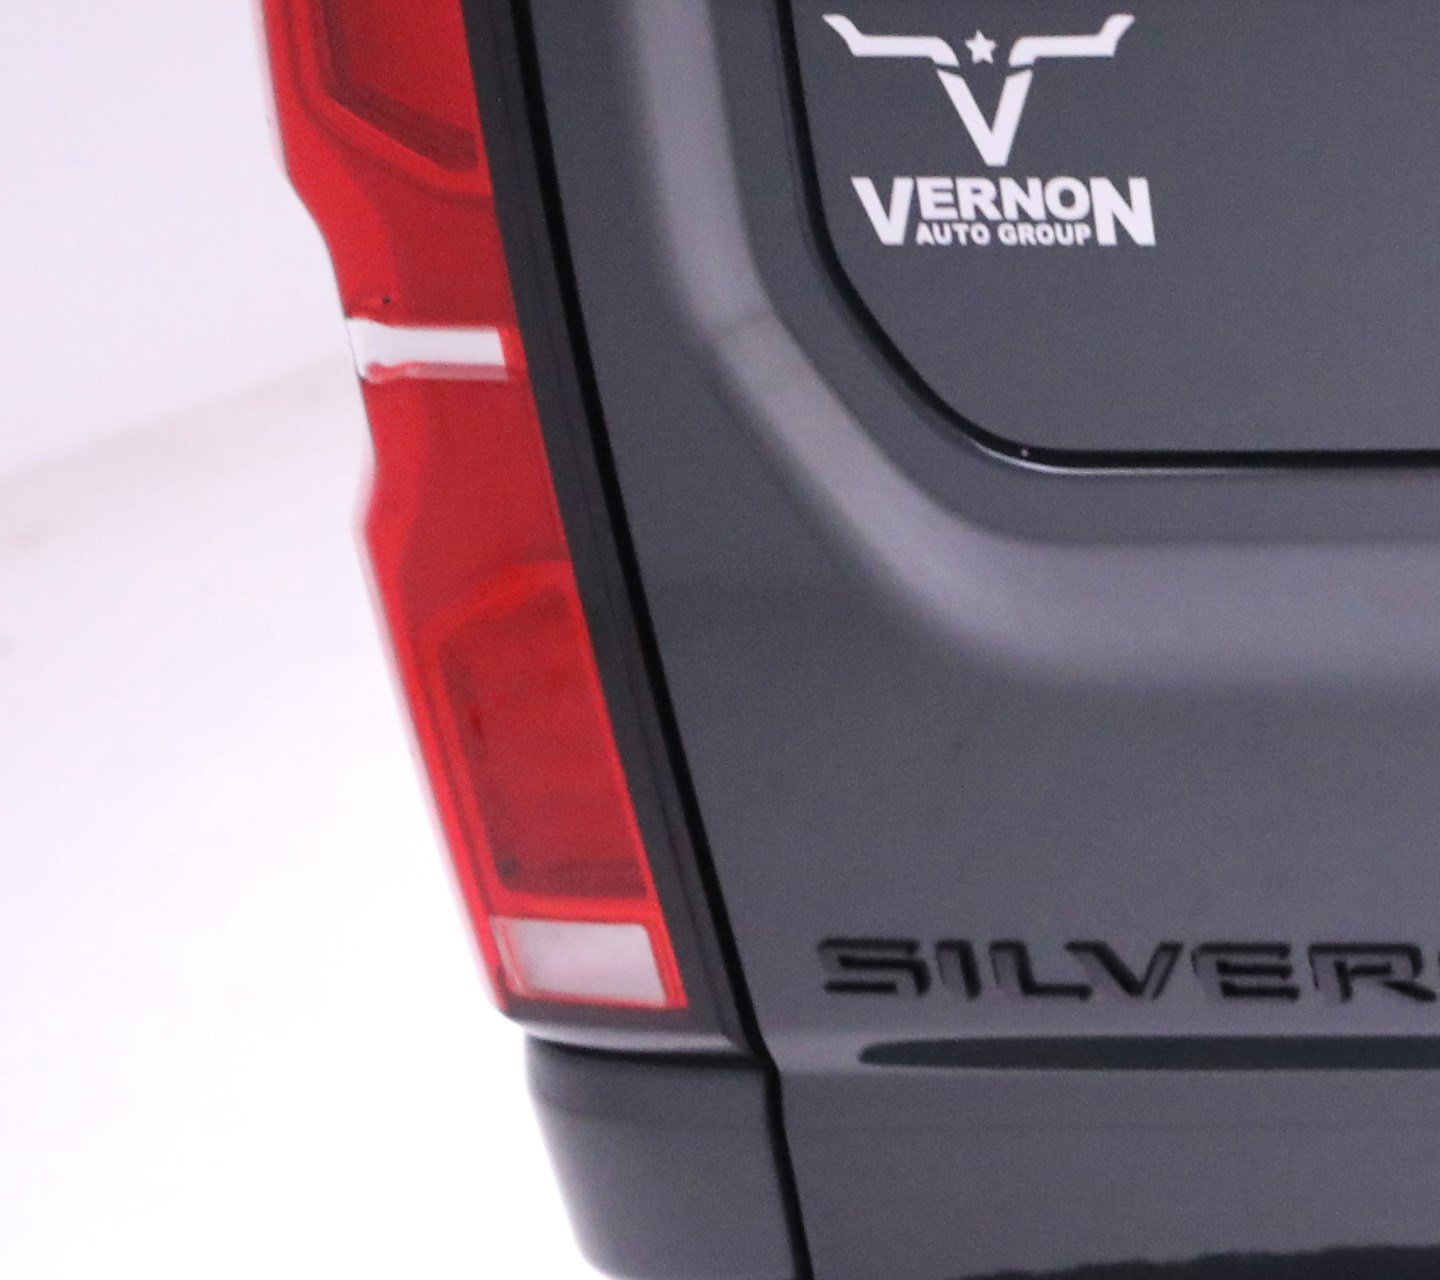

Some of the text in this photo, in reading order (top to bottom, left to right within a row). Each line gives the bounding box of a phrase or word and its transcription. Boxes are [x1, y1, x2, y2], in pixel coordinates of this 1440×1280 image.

[851, 176, 1156, 246] VERNON
[915, 222, 1092, 246] AUTO GROUP
